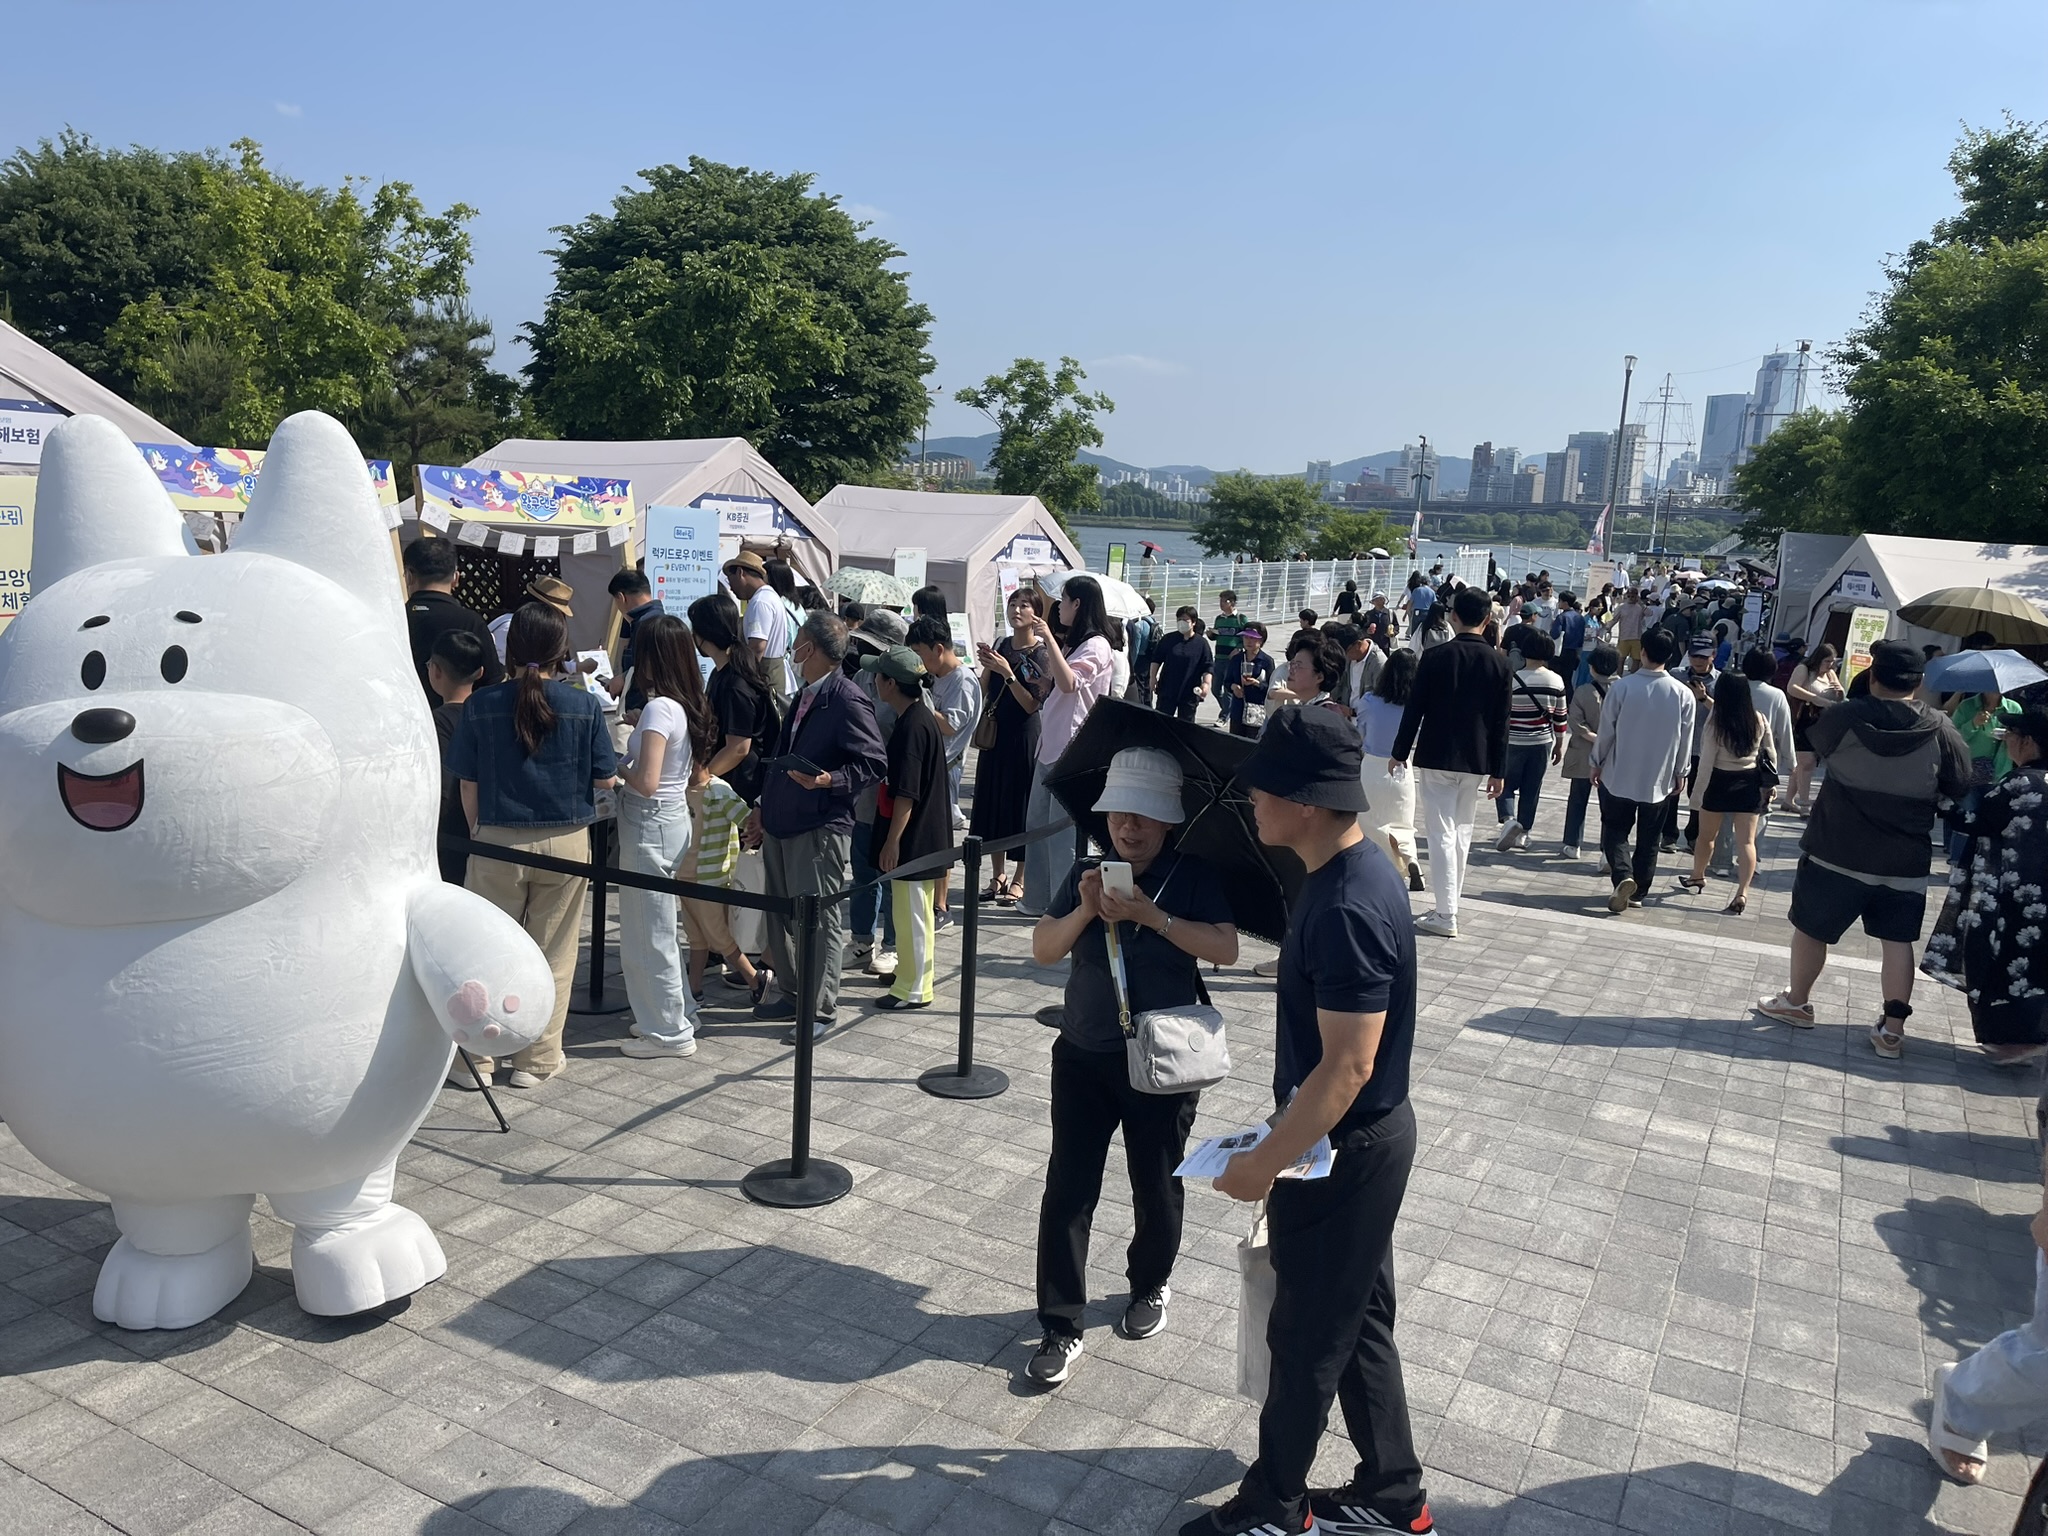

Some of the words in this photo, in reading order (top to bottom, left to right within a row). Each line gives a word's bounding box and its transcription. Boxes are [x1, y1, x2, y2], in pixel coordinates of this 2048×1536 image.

[520, 493, 558, 511] 왕구랜드
[726, 512, 749, 523] KB증권
[652, 547, 690, 561] 럭키드로우
[691, 550, 714, 562] 이벤트
[670, 563, 691, 572] EVENT
